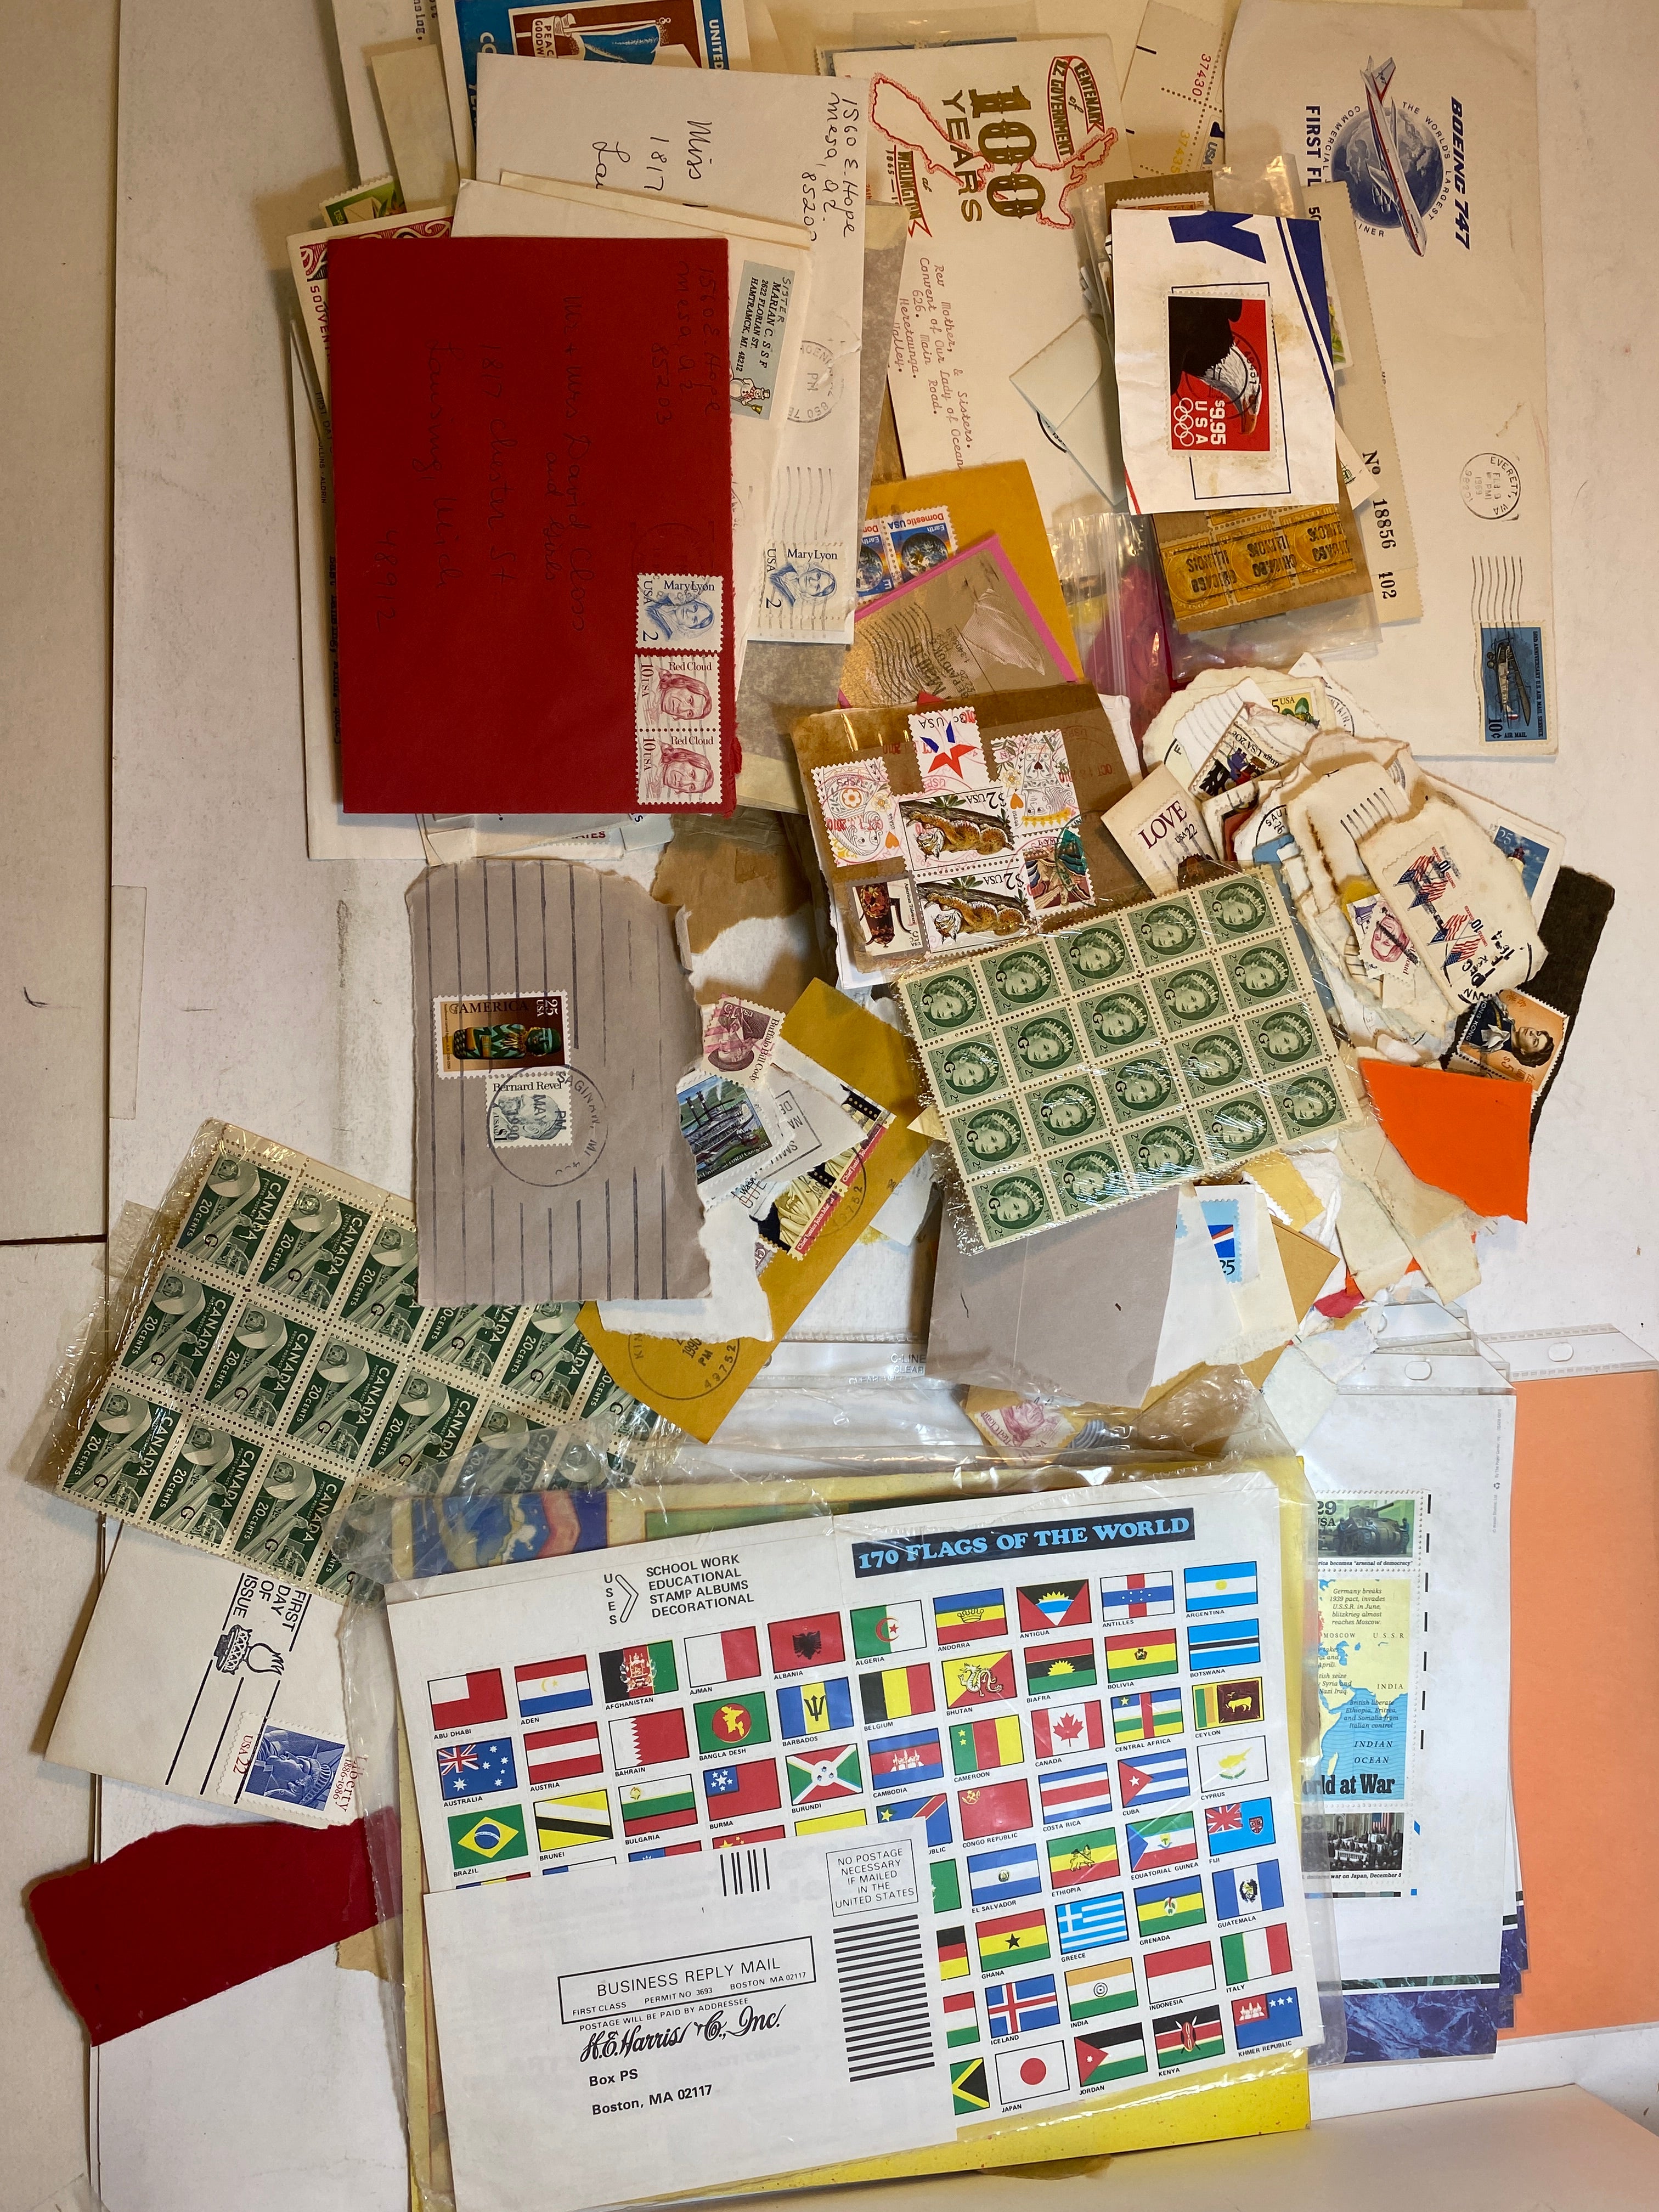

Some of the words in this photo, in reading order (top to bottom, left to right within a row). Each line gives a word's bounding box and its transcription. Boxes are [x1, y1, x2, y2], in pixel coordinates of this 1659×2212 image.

[708, 19, 724, 70] UNITED
[1192, 53, 1211, 97] 37430
[1074, 62, 1104, 127] CENTENARY
[1050, 78, 1075, 156] GOVERNMENT
[1403, 101, 1420, 114] THE
[842, 98, 859, 146] 1560
[1323, 106, 1360, 171] COMMERCIAL
[1425, 116, 1451, 159] WORLD'S
[1451, 97, 1466, 194] BOEING
[687, 121, 712, 179] Miss
[942, 90, 983, 222] YEARS
[969, 85, 1046, 219] 100
[1428, 170, 1452, 220] LARGEST
[1455, 199, 1470, 250] 747
[759, 279, 768, 296] 2622
[919, 257, 933, 312] Convent
[741, 277, 759, 334] HAMTRAMCK,
[766, 281, 781, 326] MARIAN
[753, 297, 766, 336] FLORIAN
[931, 319, 942, 334] of
[740, 337, 748, 348] MI.
[751, 337, 759, 348] ST.
[764, 328, 773, 337] C.
[899, 298, 919, 379] Heretaunga.
[736, 352, 745, 372] 48212
[912, 290, 926, 318] 626.
[919, 334, 931, 365] Main
[928, 379, 941, 414] Road.
[934, 340, 945, 364] Our
[934, 264, 944, 287] Rev
[941, 302, 955, 351] Mother,
[957, 391, 972, 448] Sisters.
[759, 360, 768, 368] F
[940, 370, 951, 402] Lady
[946, 408, 957, 423] of
[1210, 399, 1226, 445] $9.95
[951, 428, 963, 470] Ocean
[1362, 450, 1381, 475] No
[1373, 499, 1396, 549] 18856
[888, 521, 906, 529] USA
[906, 513, 944, 526] Domestic
[766, 549, 776, 573] USA
[787, 549, 814, 562] Mary
[815, 550, 838, 562] Lyon
[766, 597, 782, 608] 2
[642, 738, 656, 752] 10
[671, 736, 687, 744] Red
[689, 736, 713, 744] Cloud
[643, 753, 651, 771] USA
[966, 792, 987, 803] USA
[988, 789, 1007, 809] $2
[1138, 800, 1187, 849] LOVE
[1175, 830, 1187, 844] USA
[1184, 823, 1198, 839] 22
[903, 883, 913, 904] American
[907, 904, 917, 924] Toleware
[459, 1001, 528, 1013] AMERICA
[545, 999, 558, 1015] 25
[758, 1018, 780, 1052] Buffalo
[755, 1049, 769, 1065] Bill
[750, 1063, 764, 1084] Cody
[493, 1082, 534, 1092] Bernard
[536, 1080, 563, 1090] Revel
[229, 1350, 240, 1366] 20
[274, 1334, 308, 1392] CANADA
[214, 1368, 229, 1389] CENTS
[858, 1550, 899, 1570] 170
[905, 1536, 988, 1562] FLAGS
[996, 1532, 1029, 1551] OF
[1034, 1525, 1088, 1547] THE
[1092, 1516, 1190, 1541] WORLD
[646, 1561, 697, 1577] SCHOOL
[701, 1554, 740, 1568] WORK
[648, 1568, 742, 1590] EDUCATIONAL
[233, 1575, 258, 1618] ISSUE
[258, 1580, 274, 1601] OF
[270, 1585, 291, 1616] DAY
[650, 1589, 691, 1604] STAMP
[696, 1581, 748, 1596] ALBUMS
[282, 1590, 307, 1632] FIRST
[652, 1594, 754, 1618] DECORATIONAL
[1190, 1669, 1225, 1678] BOTSWANA
[606, 1697, 653, 1710] AFGHANISTAN
[238, 1735, 253, 1755] USA
[1115, 1743, 1144, 1752] CENTRAL
[699, 1752, 726, 1760] BANGLA
[1035, 1758, 1062, 1767] CANADA
[233, 1759, 251, 1774] 22
[615, 1768, 645, 1776] BAHRAIN
[333, 1759, 351, 1801] 1886-1986
[1340, 1775, 1357, 1794] at
[1359, 1773, 1395, 1794] War
[444, 1796, 482, 1807] AUSTRALIA
[838, 1857, 852, 1865] NO
[856, 1848, 902, 1867] POSTAGE
[841, 1859, 901, 1876] NECESSARY
[454, 1869, 478, 1877] BRAZIL
[860, 1871, 896, 1882] MAILED
[872, 1882, 889, 1891] THE
[836, 1895, 871, 1908] UNITED
[876, 1888, 913, 1901] STATES
[982, 1900, 1016, 1911] SALVADOR
[1218, 1916, 1256, 1928] GUATEMALA
[1062, 1953, 1085, 1962] GREECE
[597, 1973, 678, 1997] BUSINESS
[685, 1965, 734, 1983] REPLY
[741, 1957, 781, 1974] MAIL
[580, 2019, 619, 2031] POSTAGE
[661, 2010, 680, 2018] PAID
[699, 1998, 747, 2011] ADDRESSEE
[1149, 1999, 1183, 2010] INDONESIA
[991, 2035, 1019, 2045] ICELAND
[1238, 2048, 1260, 2057] KHMER
[1262, 2041, 1291, 2051] REPUBLIC
[589, 2075, 615, 2086] Box
[620, 2069, 637, 2081] PS
[592, 2101, 643, 2115] Boston,
[650, 2092, 673, 2105] MA
[678, 2085, 712, 2100] 02117
[1002, 2104, 1022, 2112] JAPAN
